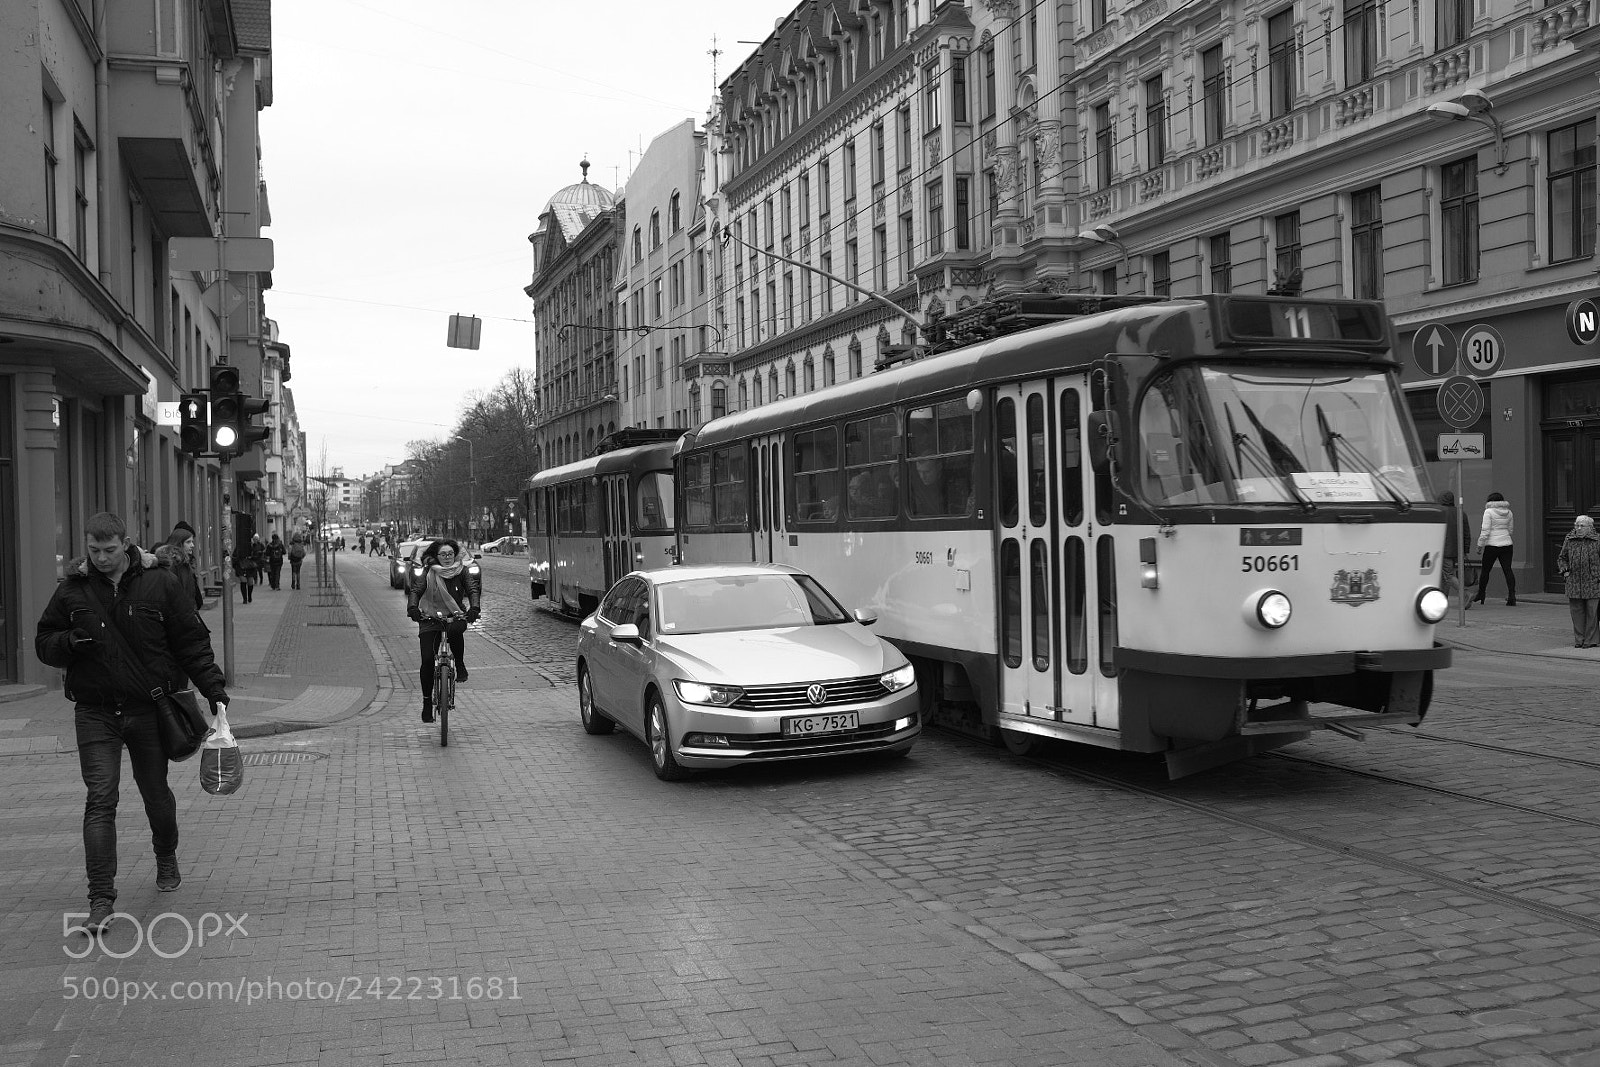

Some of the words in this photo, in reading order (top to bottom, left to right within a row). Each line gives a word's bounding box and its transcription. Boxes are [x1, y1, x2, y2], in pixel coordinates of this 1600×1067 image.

[1284, 306, 1311, 339] 11
[1579, 311, 1595, 332] N
[1472, 339, 1494, 363] 30
[915, 551, 933, 565] 50661
[1241, 554, 1300, 573] 50661
[793, 714, 855, 733] KG-7521
